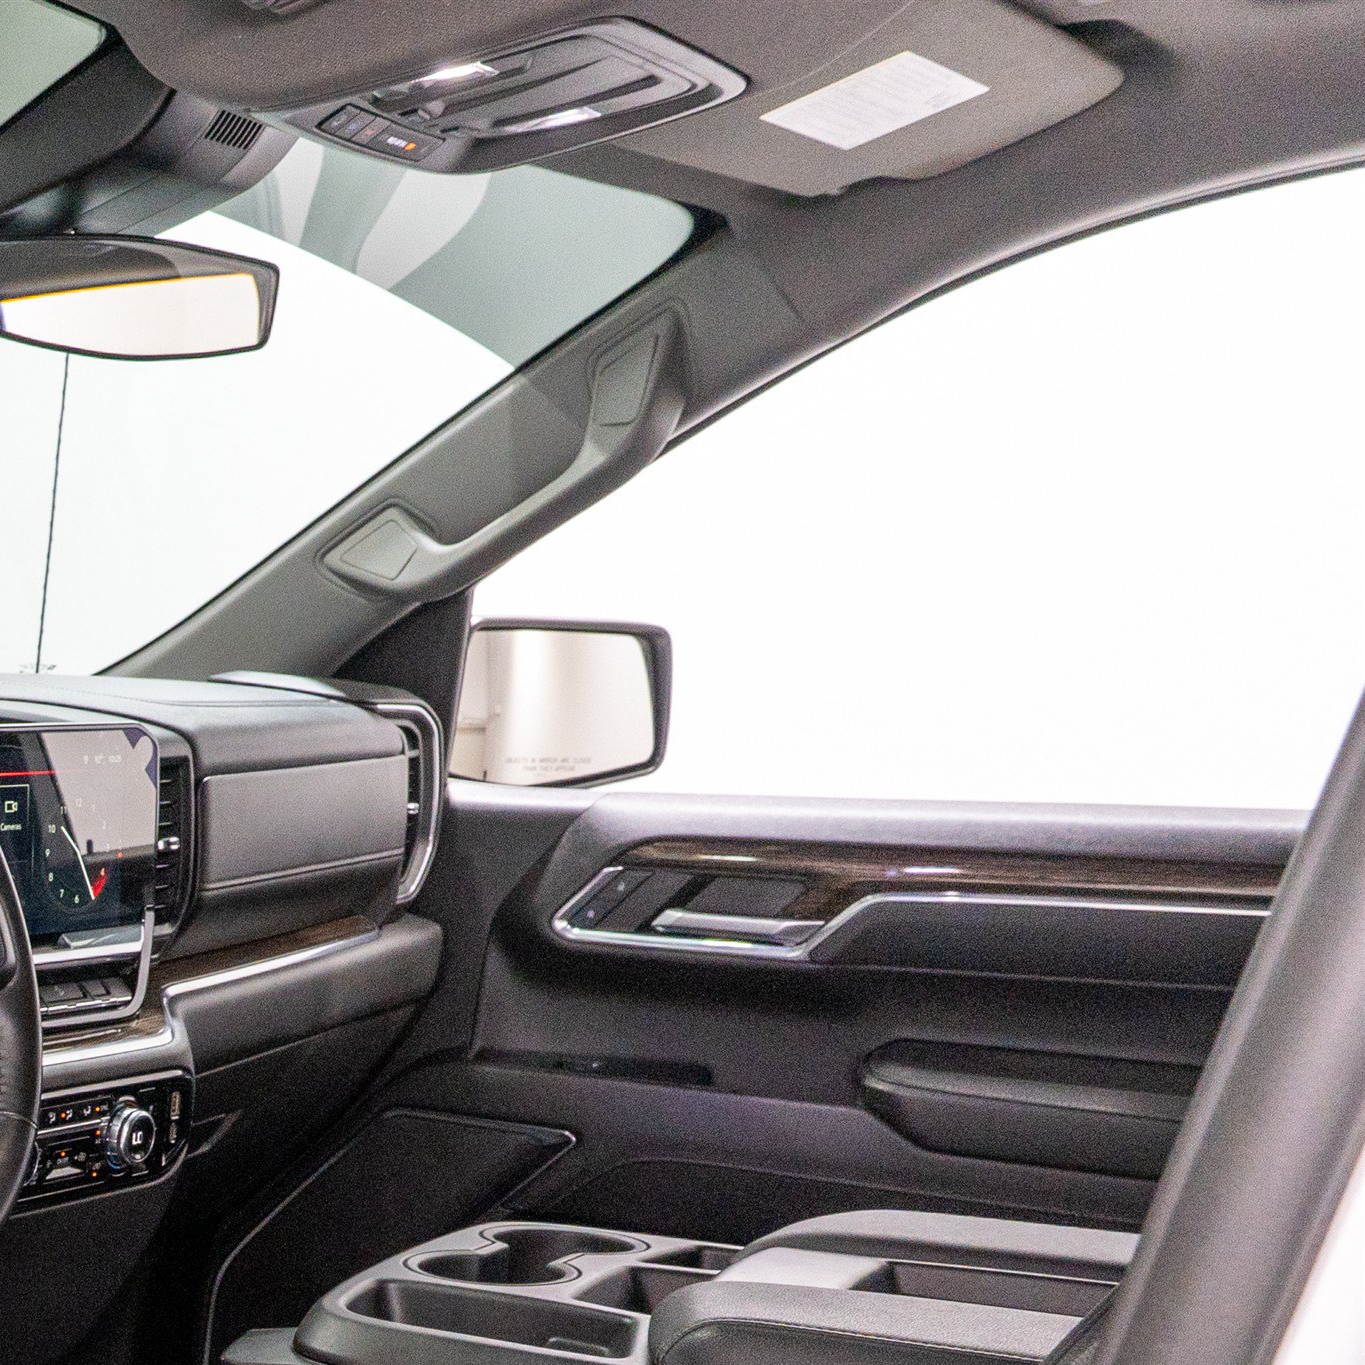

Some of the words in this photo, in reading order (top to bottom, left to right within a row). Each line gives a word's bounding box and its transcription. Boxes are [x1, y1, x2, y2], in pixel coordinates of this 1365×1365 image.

[0, 822, 22, 831] Cameras
[47, 824, 56, 834] 10
[44, 848, 51, 857] 9
[48, 872, 54, 882] 8
[60, 889, 65, 898] 7
[74, 894, 80, 904] 6
